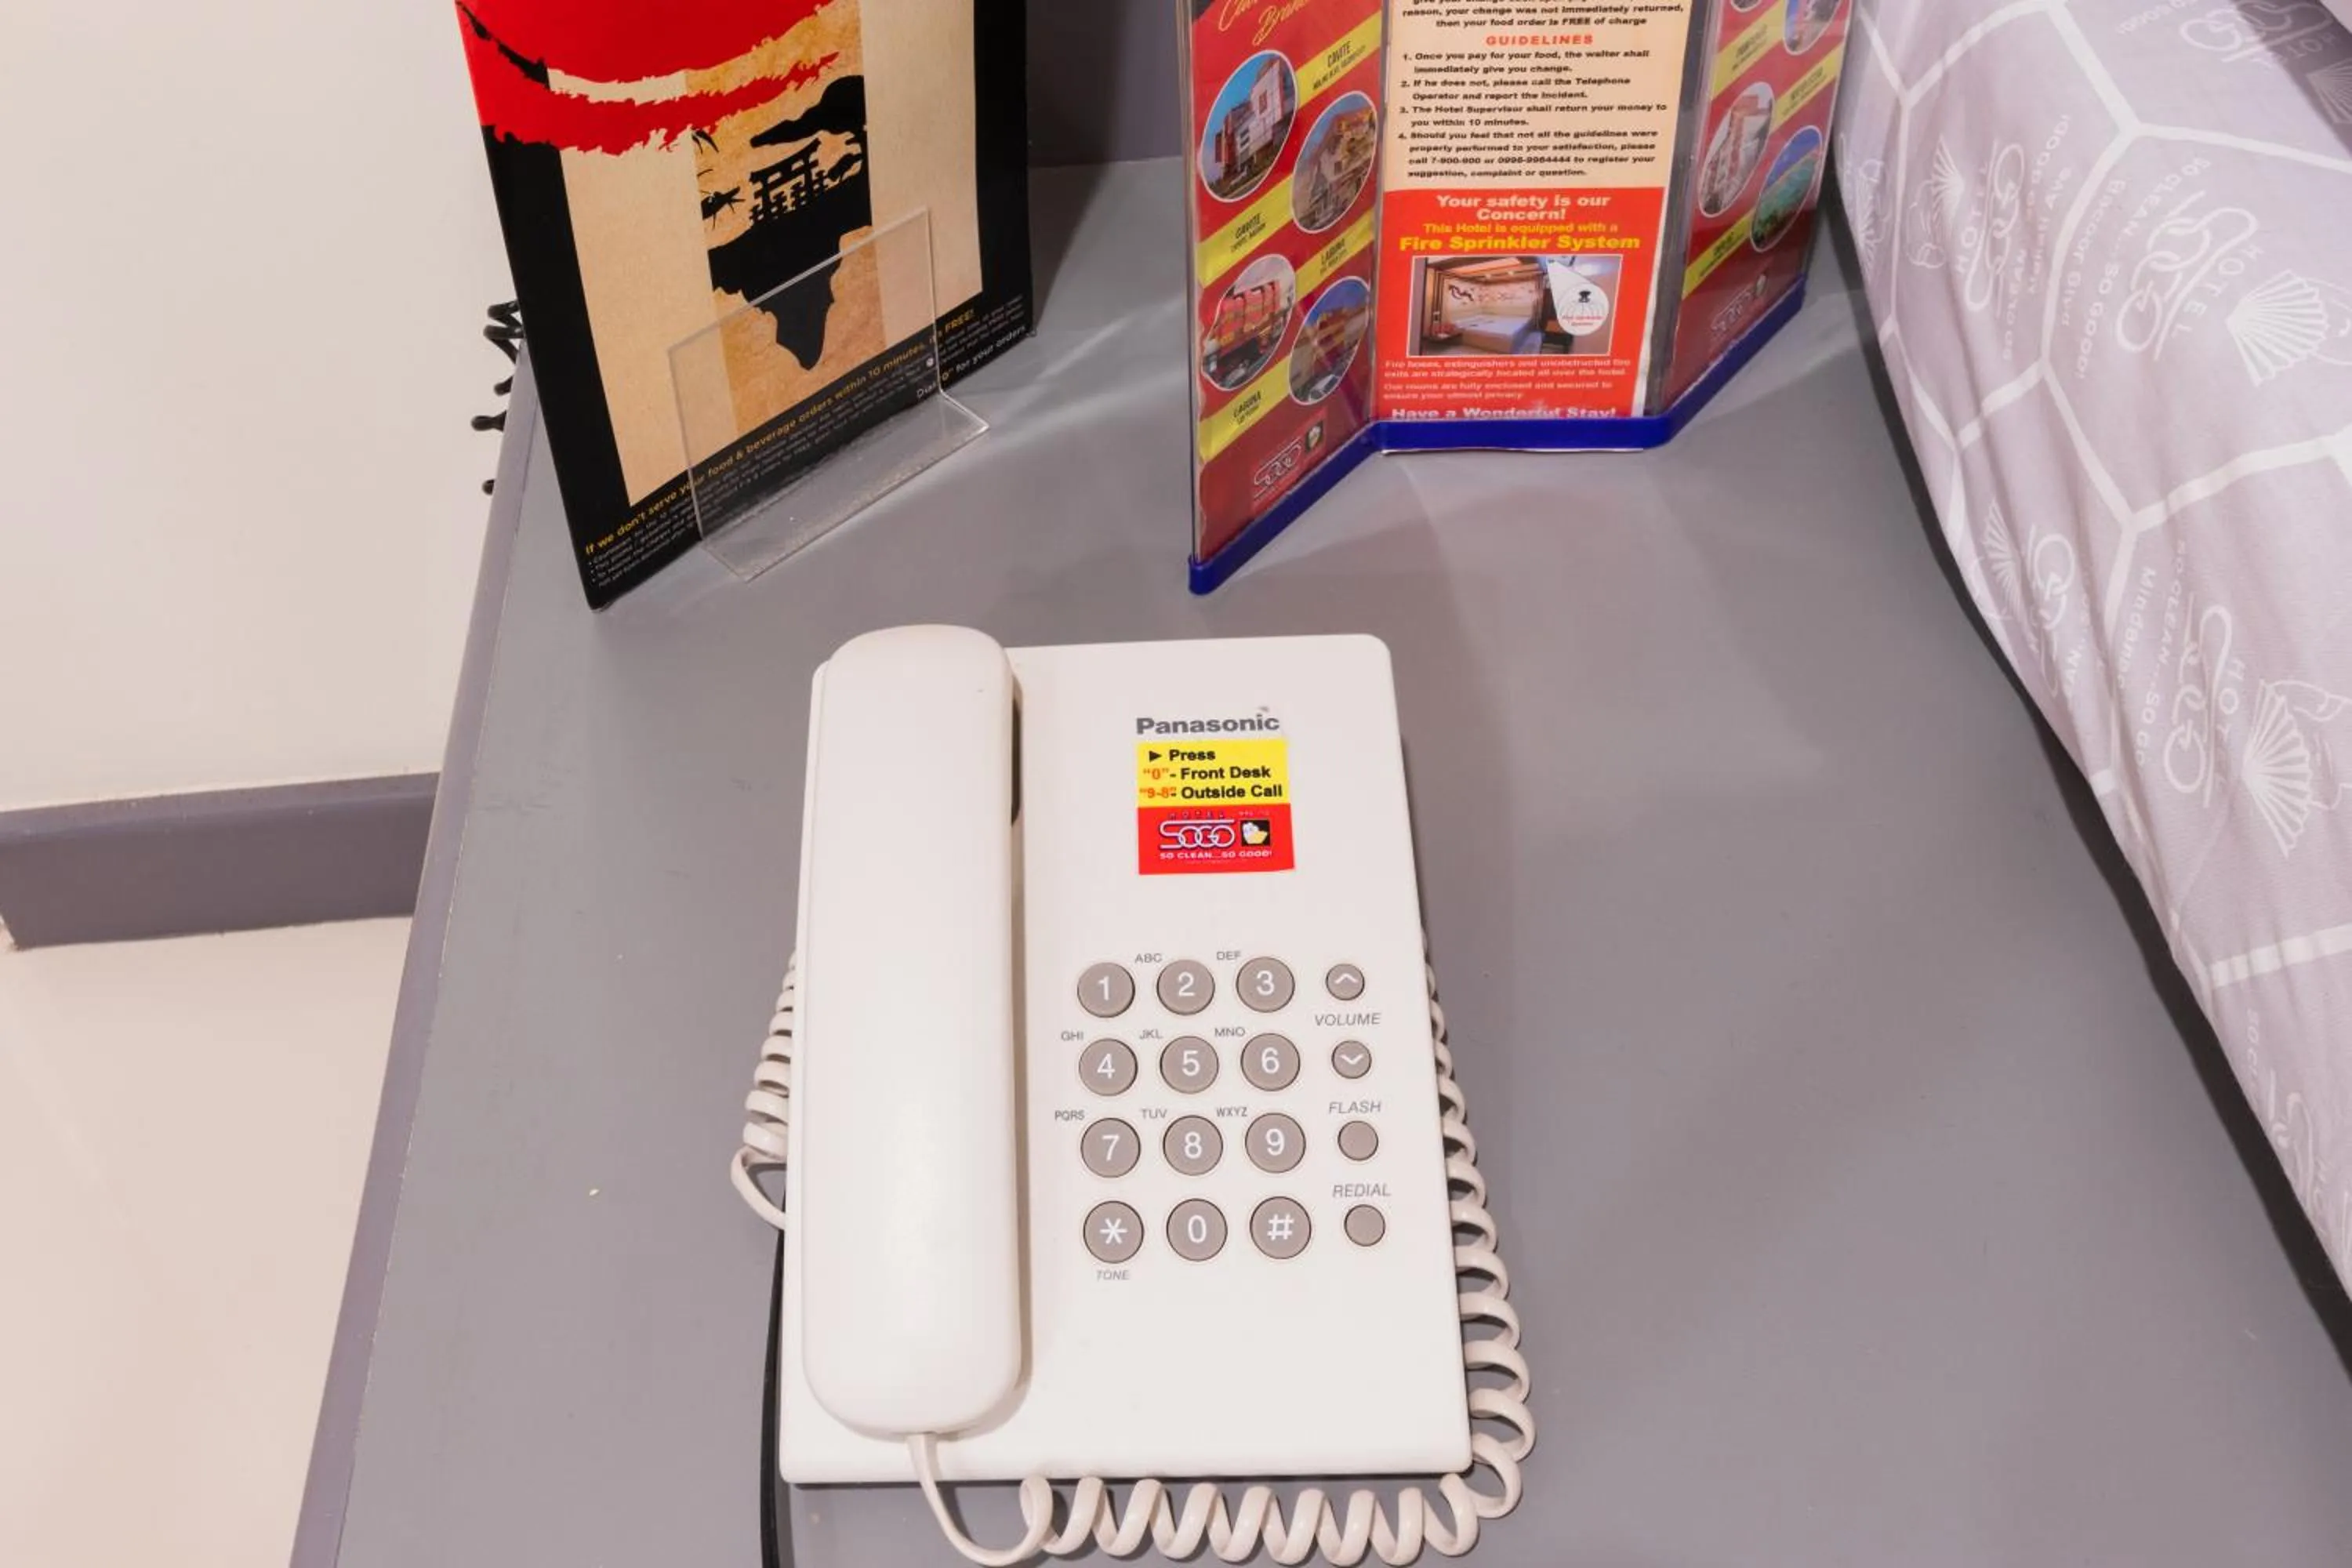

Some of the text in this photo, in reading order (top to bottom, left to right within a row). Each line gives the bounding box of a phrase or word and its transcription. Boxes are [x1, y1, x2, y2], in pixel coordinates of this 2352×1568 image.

[1486, 35, 1593, 45] GUIDELINES
[1534, 51, 1561, 60] food,
[1414, 66, 1479, 74] immediately
[1482, 66, 1505, 74] give
[1493, 78, 1528, 87] please
[1576, 77, 1631, 86] Telephone
[1413, 92, 1459, 101] Operator
[1462, 91, 1481, 100] and
[1485, 92, 1518, 100] report
[1522, 90, 1539, 99] the
[1467, 106, 1523, 115] Supervisor
[1617, 104, 1653, 113] money
[1573, 130, 1628, 139] guidelines
[1409, 143, 1452, 154] properly
[1455, 144, 1510, 153] performed
[1621, 143, 1656, 151] please
[1588, 155, 1629, 165] register
[1471, 169, 1523, 179] complaint
[1436, 194, 1611, 210] Your safety is our
[1476, 208, 1566, 221] Concern!
[1423, 223, 1606, 235] This Hotel is equipped with
[1399, 235, 1640, 252] Fire Sprinkler System
[2171, 243, 2265, 339] HOTEL
[956, 325, 1025, 372] for your orders
[1392, 408, 1439, 419] Have
[1462, 407, 1559, 419] Wonderful
[1567, 407, 1616, 418] Stay!
[586, 308, 975, 556] If we don't serve food & beverage orders within 10 FREE!
[1136, 714, 1280, 735] Panasonic
[1169, 750, 1216, 761] Press
[1180, 766, 1272, 780] Front Desk
[1181, 783, 1283, 799] Outside Call
[1169, 810, 1225, 819] HOTEL
[1159, 818, 1236, 850] SOGO
[1134, 953, 1163, 964] ABC
[1216, 951, 1241, 961] DEF
[1098, 975, 1109, 1001] 1
[1178, 971, 1195, 996] 2
[1256, 970, 1275, 996] 3
[1315, 1012, 1381, 1026] VOLUME
[1061, 1031, 1084, 1041] GHI
[1139, 1029, 1163, 1040] JKL
[1214, 1026, 1246, 1037] MNO
[1097, 1053, 1116, 1080] 4
[1181, 1050, 1200, 1076] 5
[1261, 1047, 1279, 1074] 6
[1141, 1108, 1167, 1119] TUV
[1216, 1106, 1248, 1117] WXYZ
[1328, 1101, 1381, 1114] FLASH
[1054, 1109, 1086, 1121] PQRS
[1102, 1134, 1120, 1162] 7
[1184, 1131, 1203, 1159] 8
[1265, 1128, 1285, 1156] 9
[1332, 1182, 1392, 1198] REDIAL
[1187, 1214, 1207, 1243] 0
[1096, 1269, 1131, 1281] TONE
